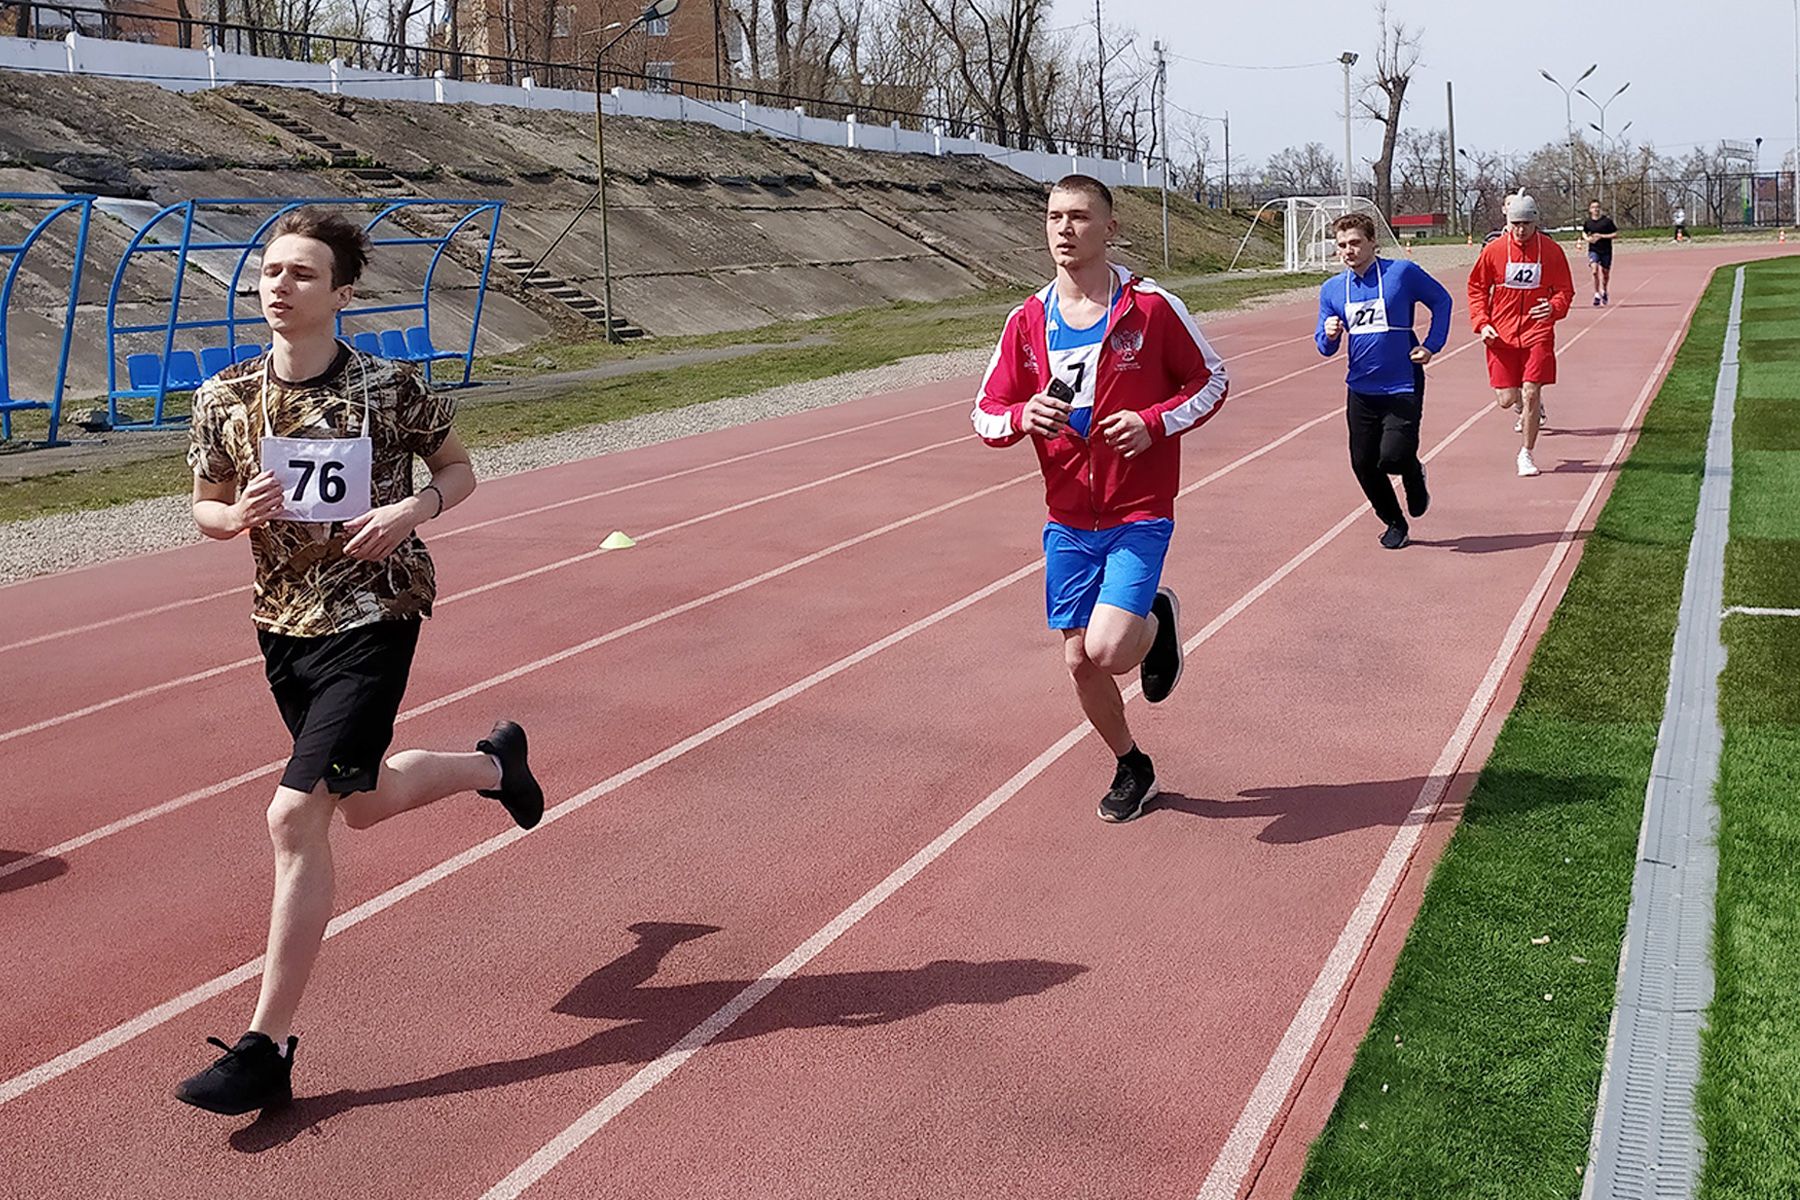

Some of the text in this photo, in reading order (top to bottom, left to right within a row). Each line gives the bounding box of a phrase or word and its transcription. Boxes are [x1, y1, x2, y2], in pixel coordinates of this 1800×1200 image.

[1513, 269, 1533, 283] 42
[1355, 308, 1375, 326] 27
[1067, 362, 1085, 392] 7
[288, 460, 347, 504] 76
